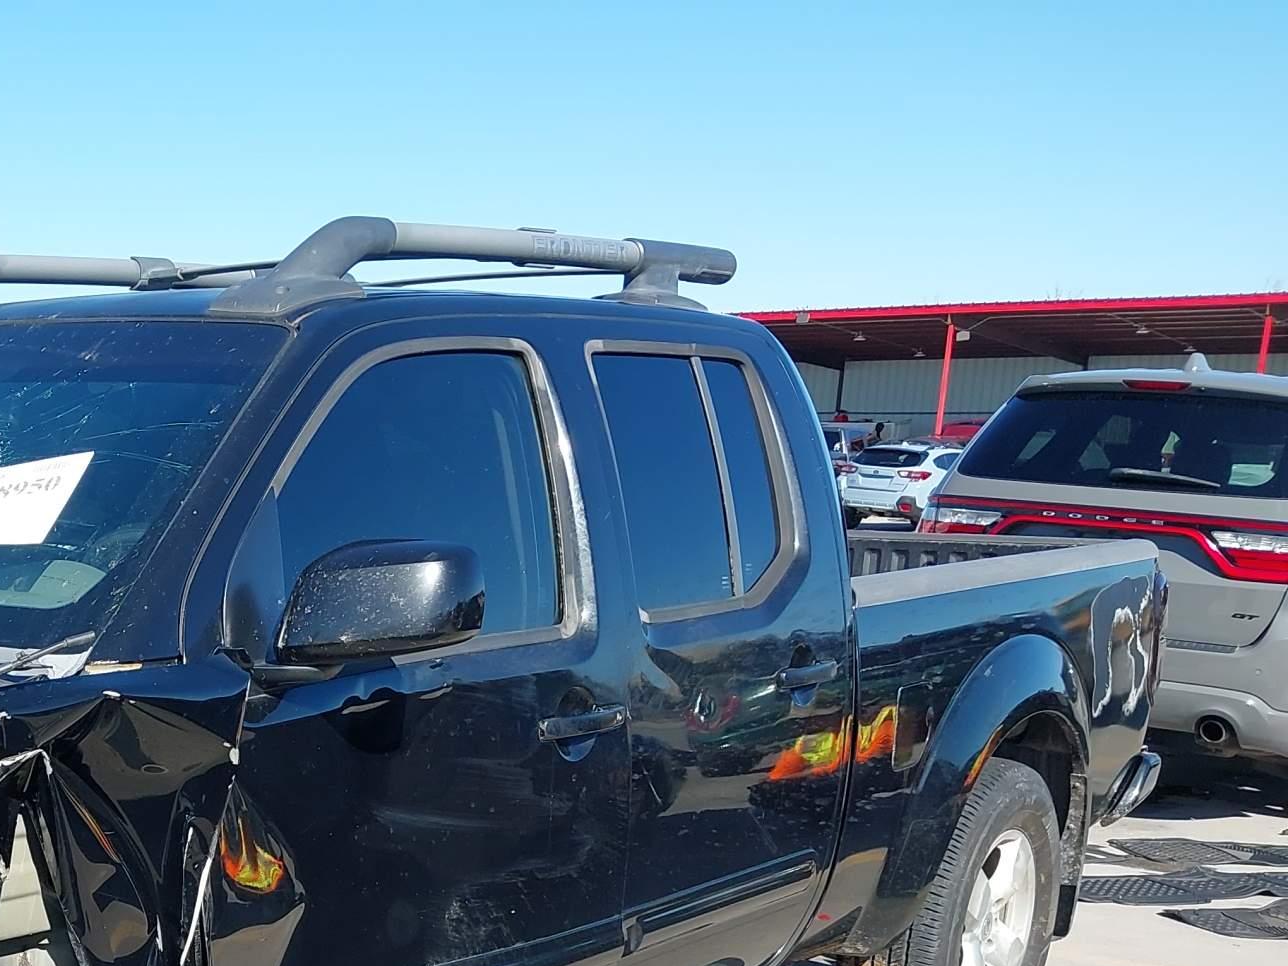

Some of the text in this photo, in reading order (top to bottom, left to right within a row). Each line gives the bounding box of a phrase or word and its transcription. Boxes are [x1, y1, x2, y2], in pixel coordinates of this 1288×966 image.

[533, 236, 626, 260] FRONTIER
[1042, 509, 1164, 527] DODGE
[1231, 612, 1260, 621] GT
